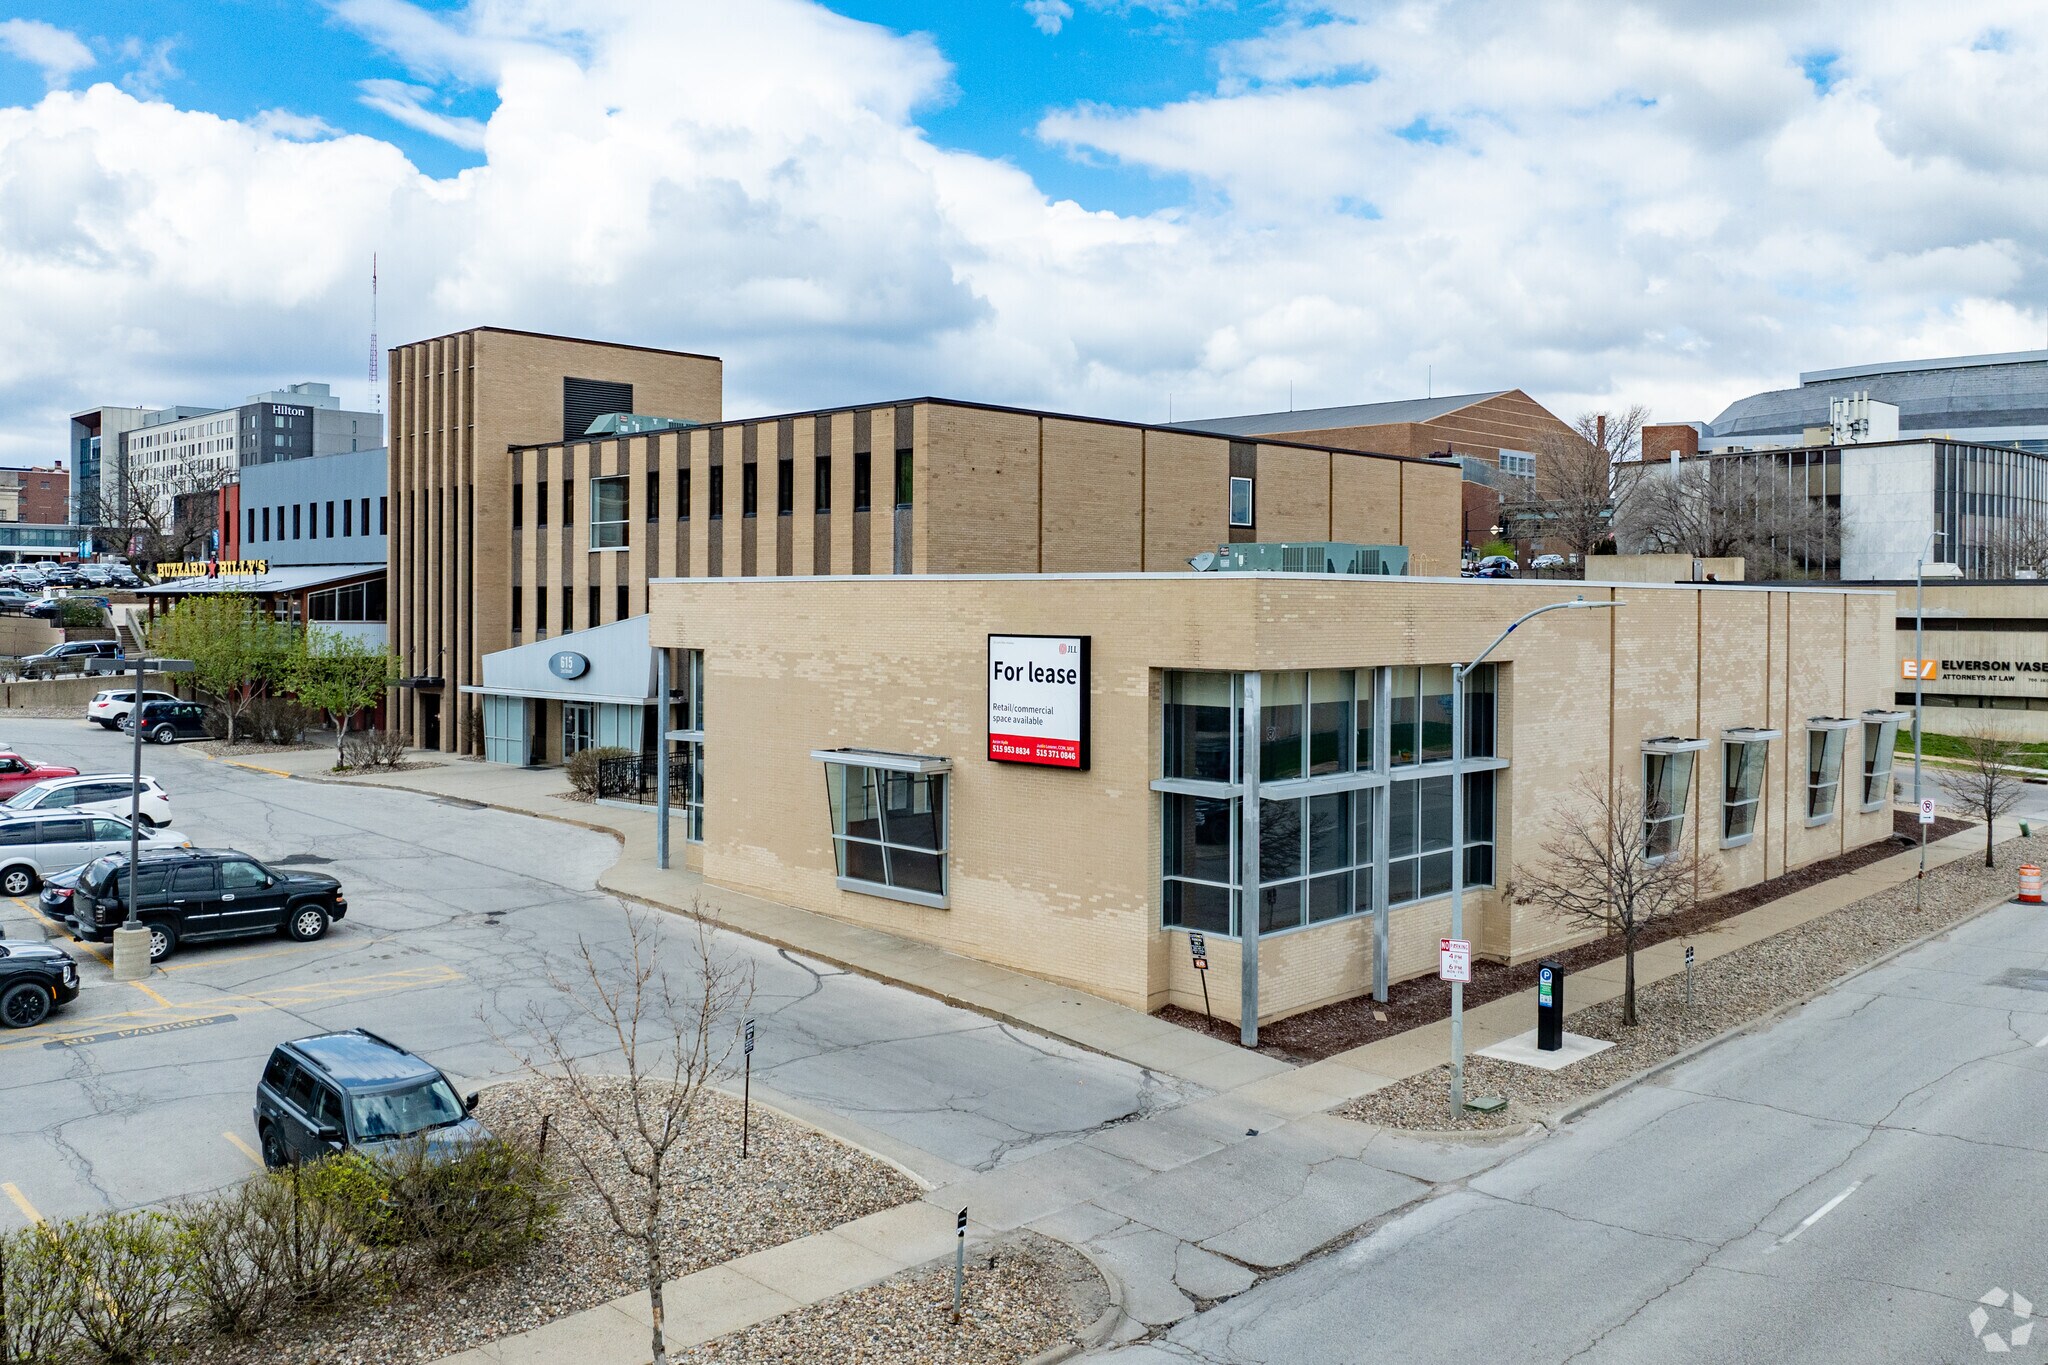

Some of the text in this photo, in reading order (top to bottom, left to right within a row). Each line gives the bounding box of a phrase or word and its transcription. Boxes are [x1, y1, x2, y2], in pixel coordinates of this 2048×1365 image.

[272, 405, 305, 416] Hilton
[156, 560, 267, 577] BUZZARD BILLY'S
[1067, 645, 1077, 654] JLL
[560, 656, 573, 669] 615
[1941, 660, 2010, 672] ELVERSON
[994, 661, 1077, 685] For lease
[1942, 673, 1986, 681] ATTORNEYS
[992, 702, 1054, 715] Retail/commercial
[992, 715, 1044, 726] space available
[1004, 746, 1015, 754] 953
[1036, 749, 1076, 760] 515 371 0846
[1441, 941, 1450, 950] NO
[63, 1017, 215, 1047] NO PARKING
